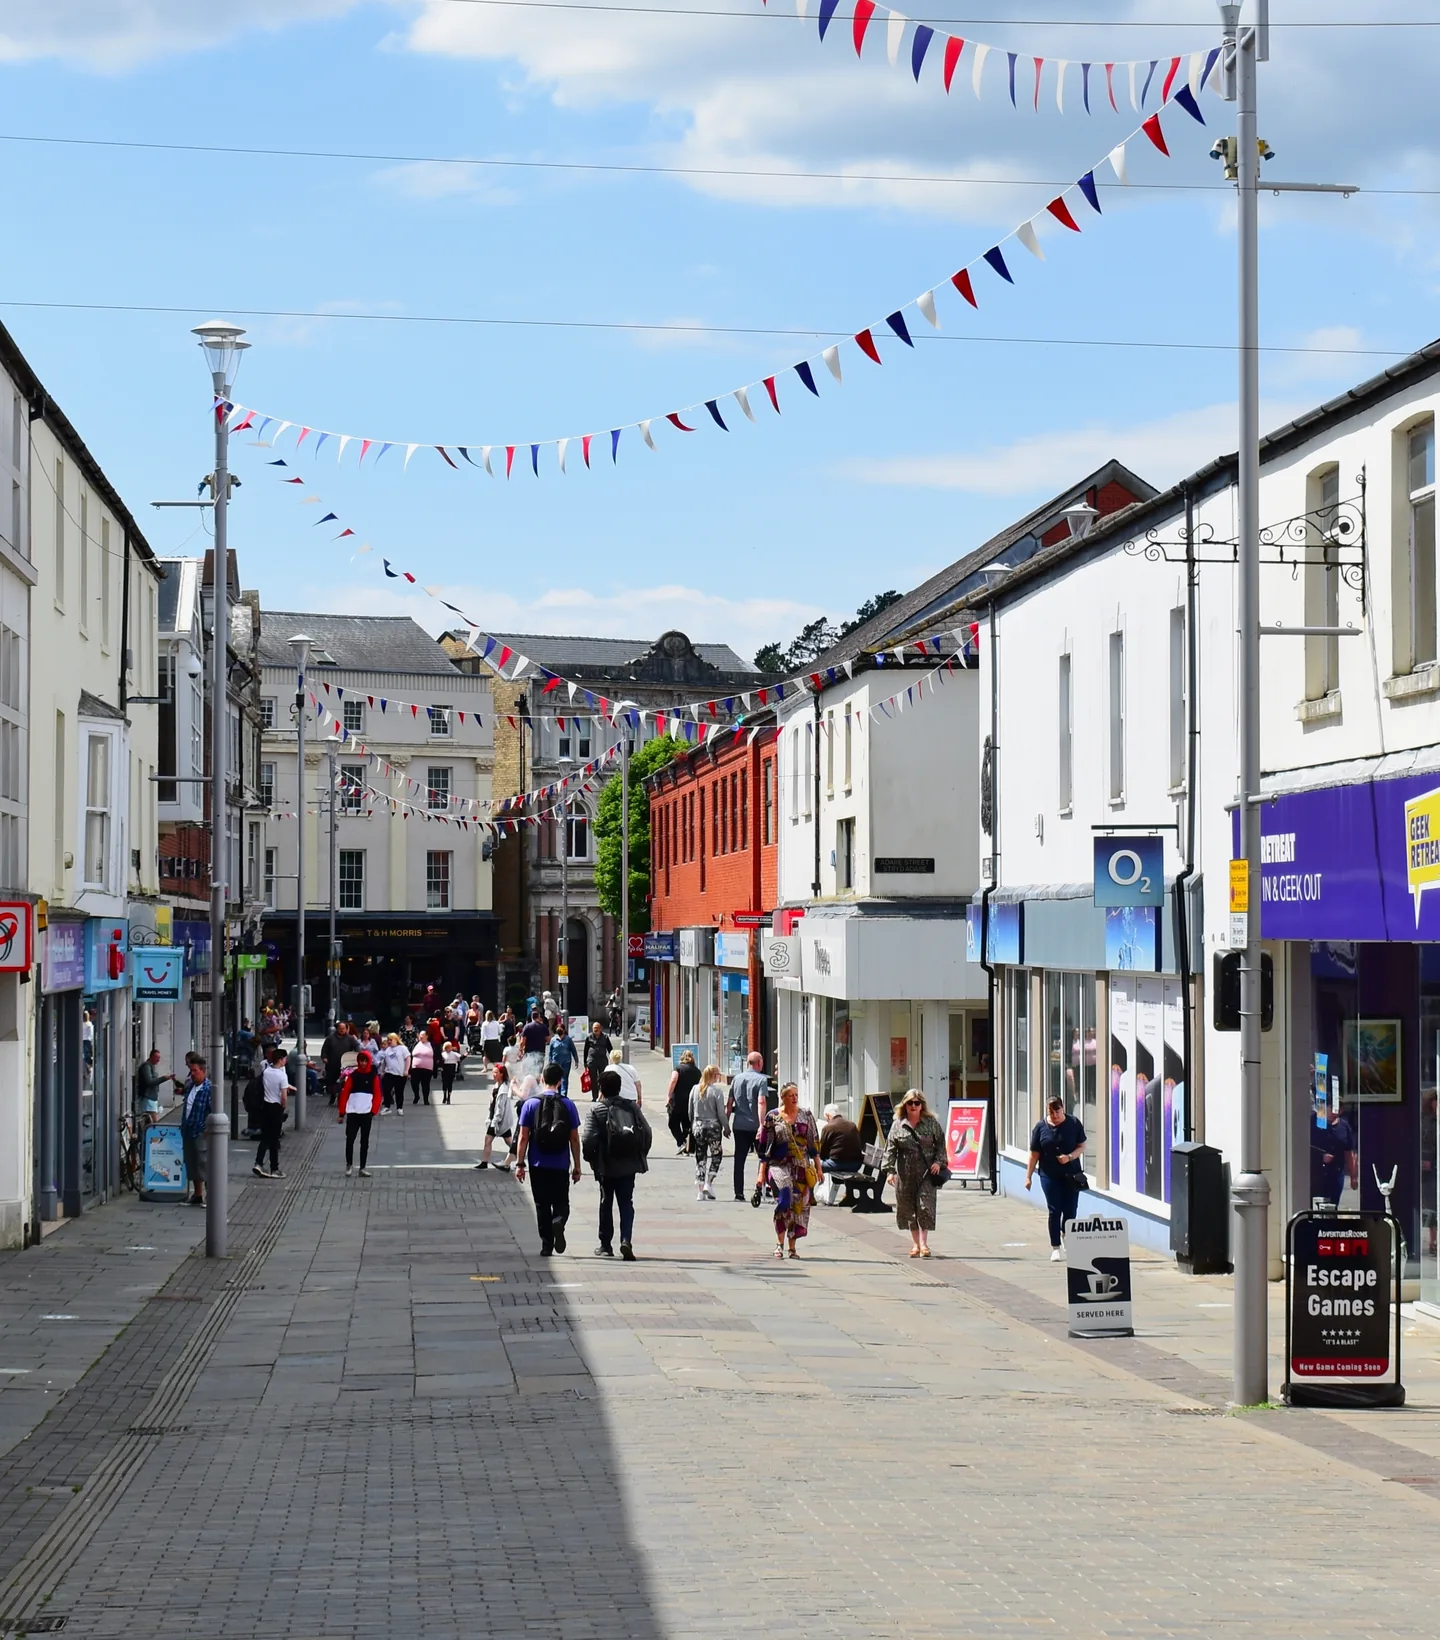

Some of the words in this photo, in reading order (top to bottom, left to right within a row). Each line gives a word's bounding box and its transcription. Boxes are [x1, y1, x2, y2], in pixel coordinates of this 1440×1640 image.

[1410, 813, 1430, 841] GEEK
[1261, 832, 1296, 864] RETREAT
[1411, 839, 1440, 869] RETREA
[1262, 876, 1271, 902] IN
[1273, 875, 1279, 902] &
[1279, 874, 1303, 902] GEEK
[1304, 873, 1322, 901] OUT
[366, 929, 373, 937] T
[373, 929, 380, 937] &
[381, 929, 388, 937] H
[389, 929, 422, 937] MORRIS
[1071, 1217, 1123, 1233] LAVAZZA
[1307, 1264, 1377, 1291] Escape
[1076, 1310, 1104, 1319] SERVED
[1106, 1309, 1125, 1317] HERE
[1308, 1294, 1375, 1316] Games
[1299, 1363, 1314, 1371] New
[1316, 1363, 1335, 1371] Game
[1337, 1363, 1362, 1372] Coming
[1364, 1363, 1381, 1371] Soon
